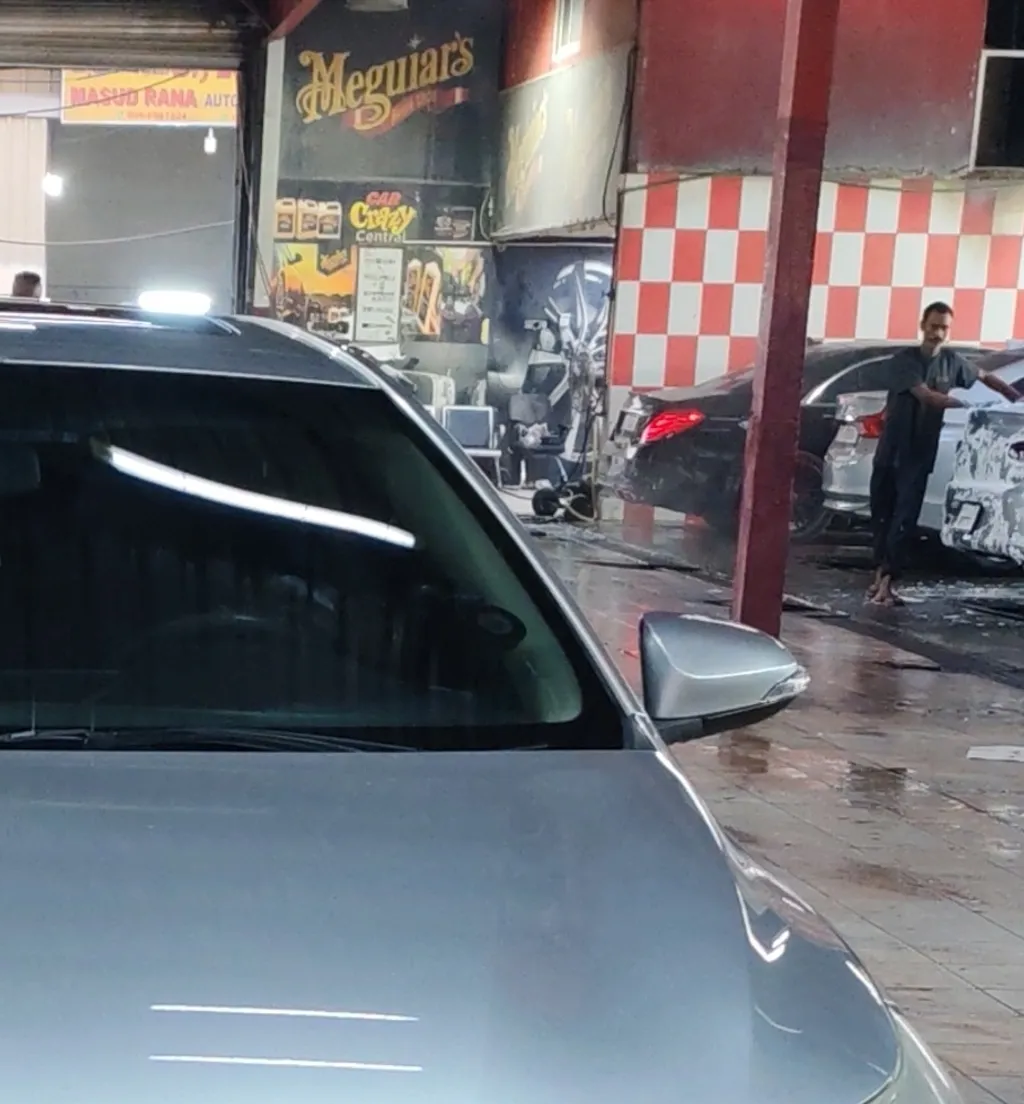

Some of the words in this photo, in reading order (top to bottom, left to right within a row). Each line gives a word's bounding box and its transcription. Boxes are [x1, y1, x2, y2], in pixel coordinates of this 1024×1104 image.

[296, 31, 474, 130] Meguiar's
[70, 86, 139, 108] MASUD
[144, 87, 198, 109] RANA
[366, 190, 402, 207] CAR
[349, 200, 417, 236] Crazy
[355, 229, 407, 244] Central
